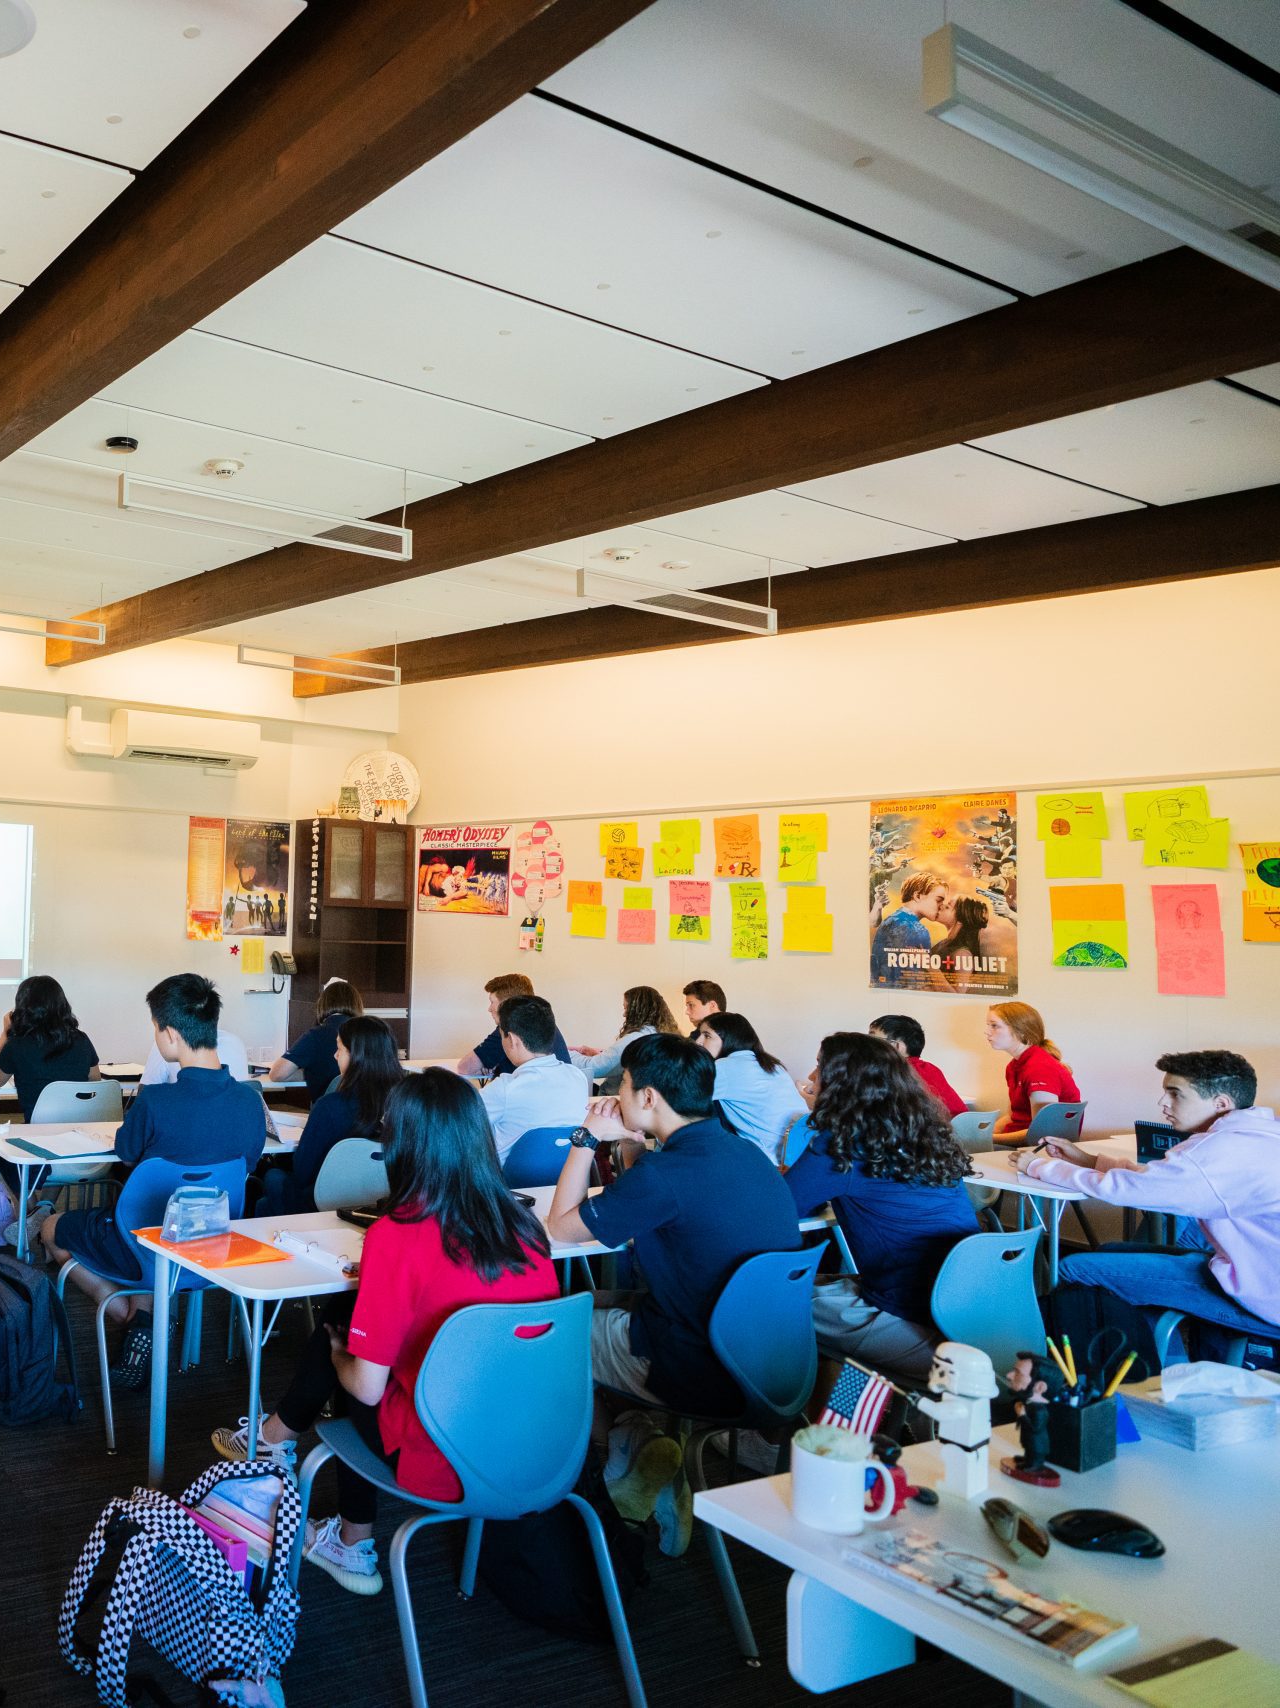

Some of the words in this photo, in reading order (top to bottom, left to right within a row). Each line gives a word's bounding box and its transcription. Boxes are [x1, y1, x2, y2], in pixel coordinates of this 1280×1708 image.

[963, 800, 984, 808] CLAIRE
[422, 826, 463, 844] HOMER'S
[463, 826, 510, 843] ODYSSEY
[887, 952, 941, 970] ROMEO
[955, 955, 1008, 973] JULIET
